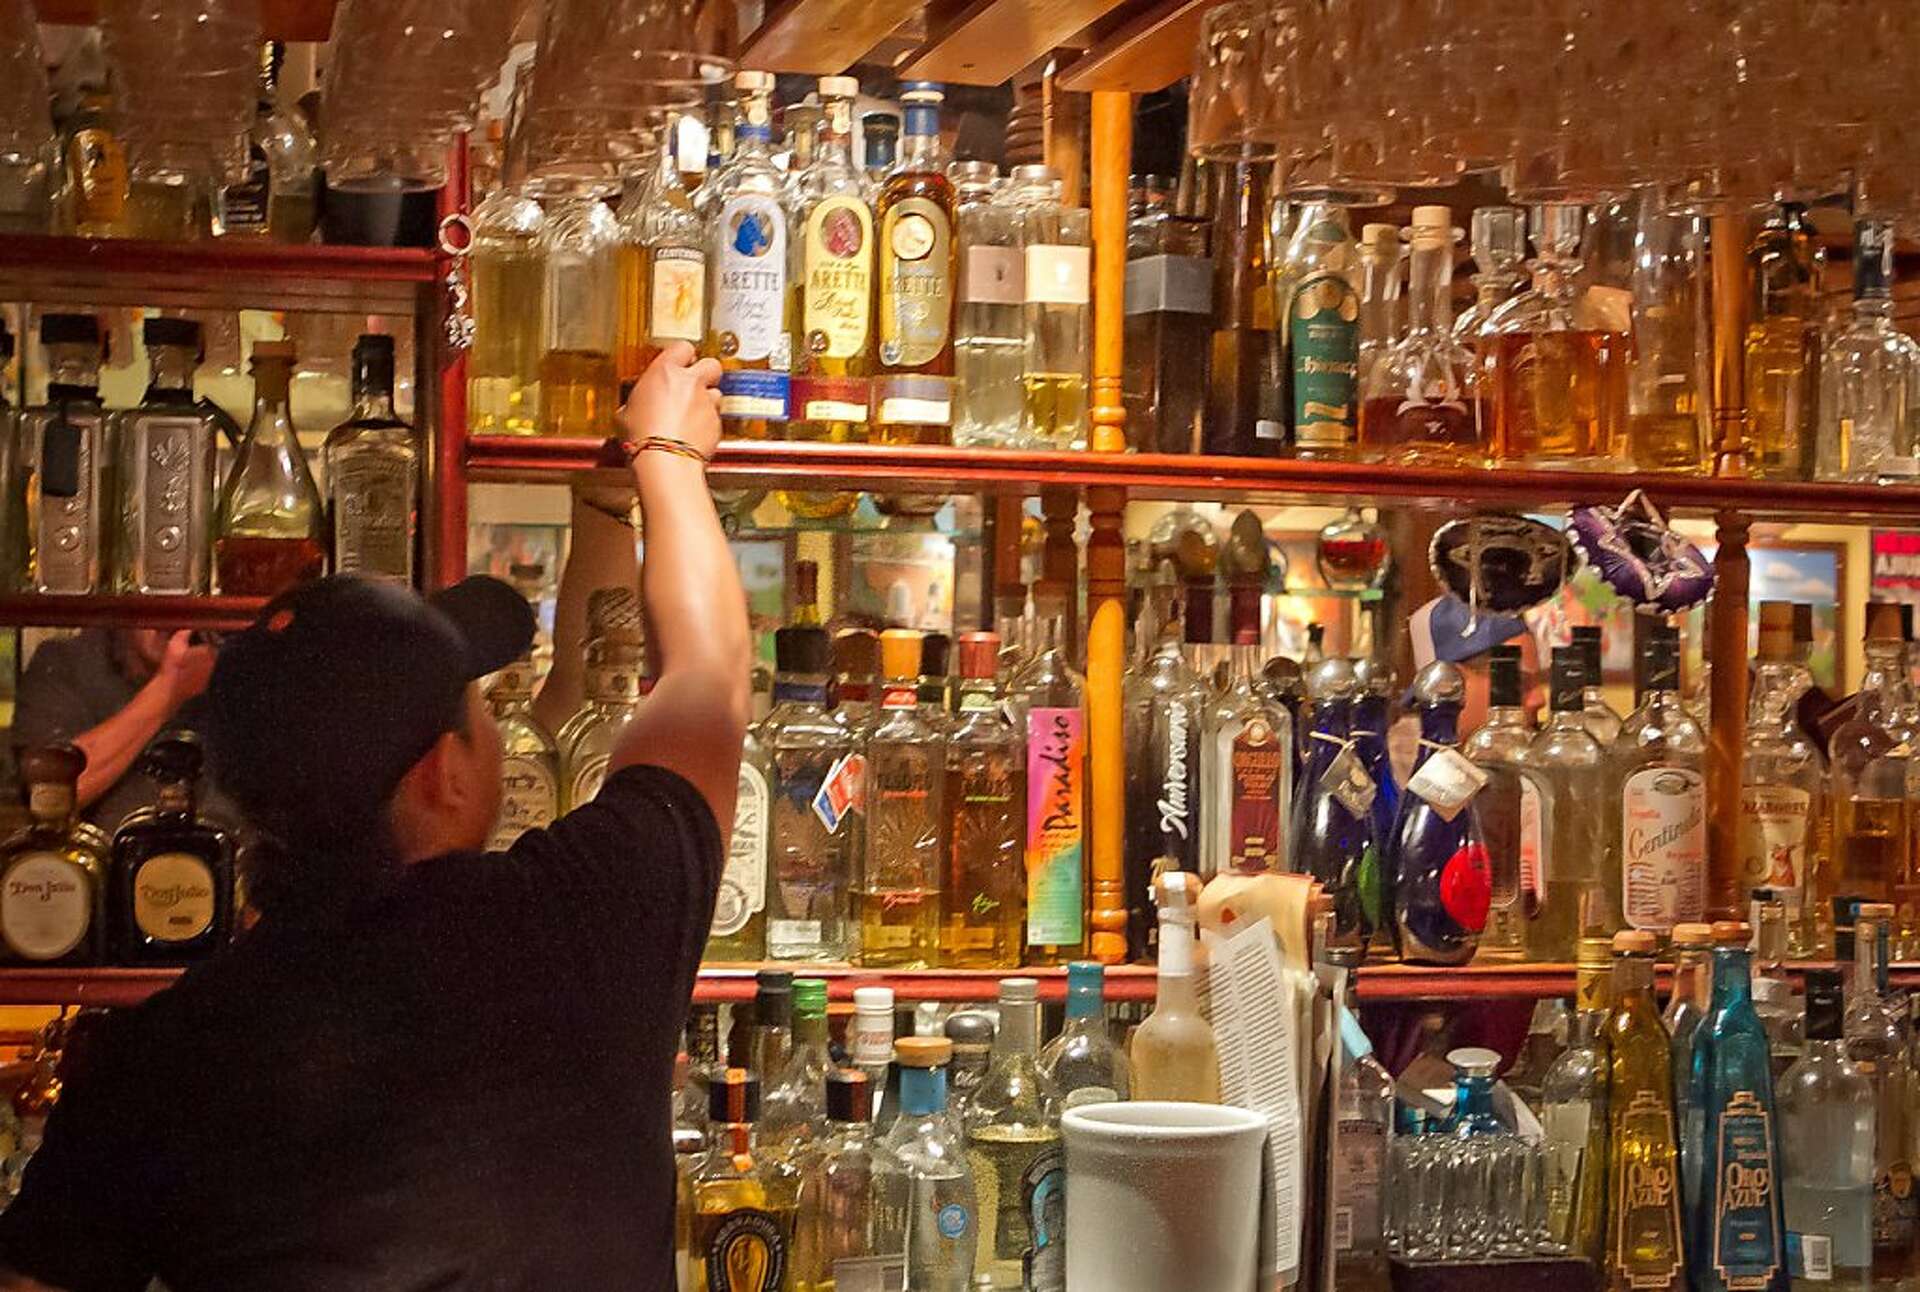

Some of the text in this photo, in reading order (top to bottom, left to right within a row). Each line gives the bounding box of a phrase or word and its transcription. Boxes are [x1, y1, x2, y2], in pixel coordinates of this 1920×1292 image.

[720, 271, 781, 291] ARETTE
[811, 270, 865, 290] ARETTE
[1042, 715, 1077, 831] Paradiso
